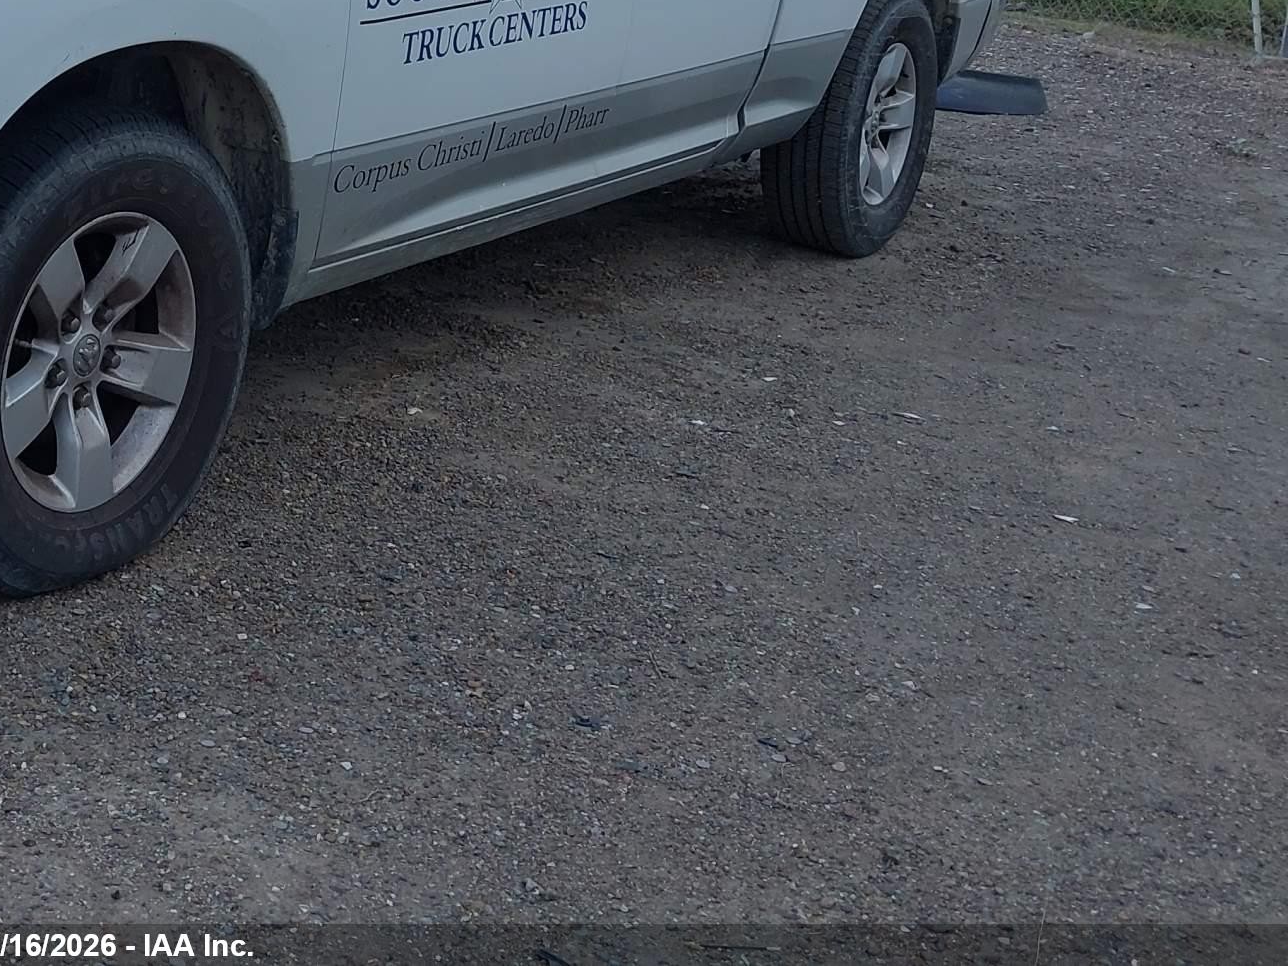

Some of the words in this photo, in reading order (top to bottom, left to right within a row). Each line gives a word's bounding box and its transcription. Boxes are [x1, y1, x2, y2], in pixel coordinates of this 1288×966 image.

[402, 18, 486, 65] TRUCK
[489, 1, 589, 46] CENTERS
[333, 157, 412, 194] Corpus
